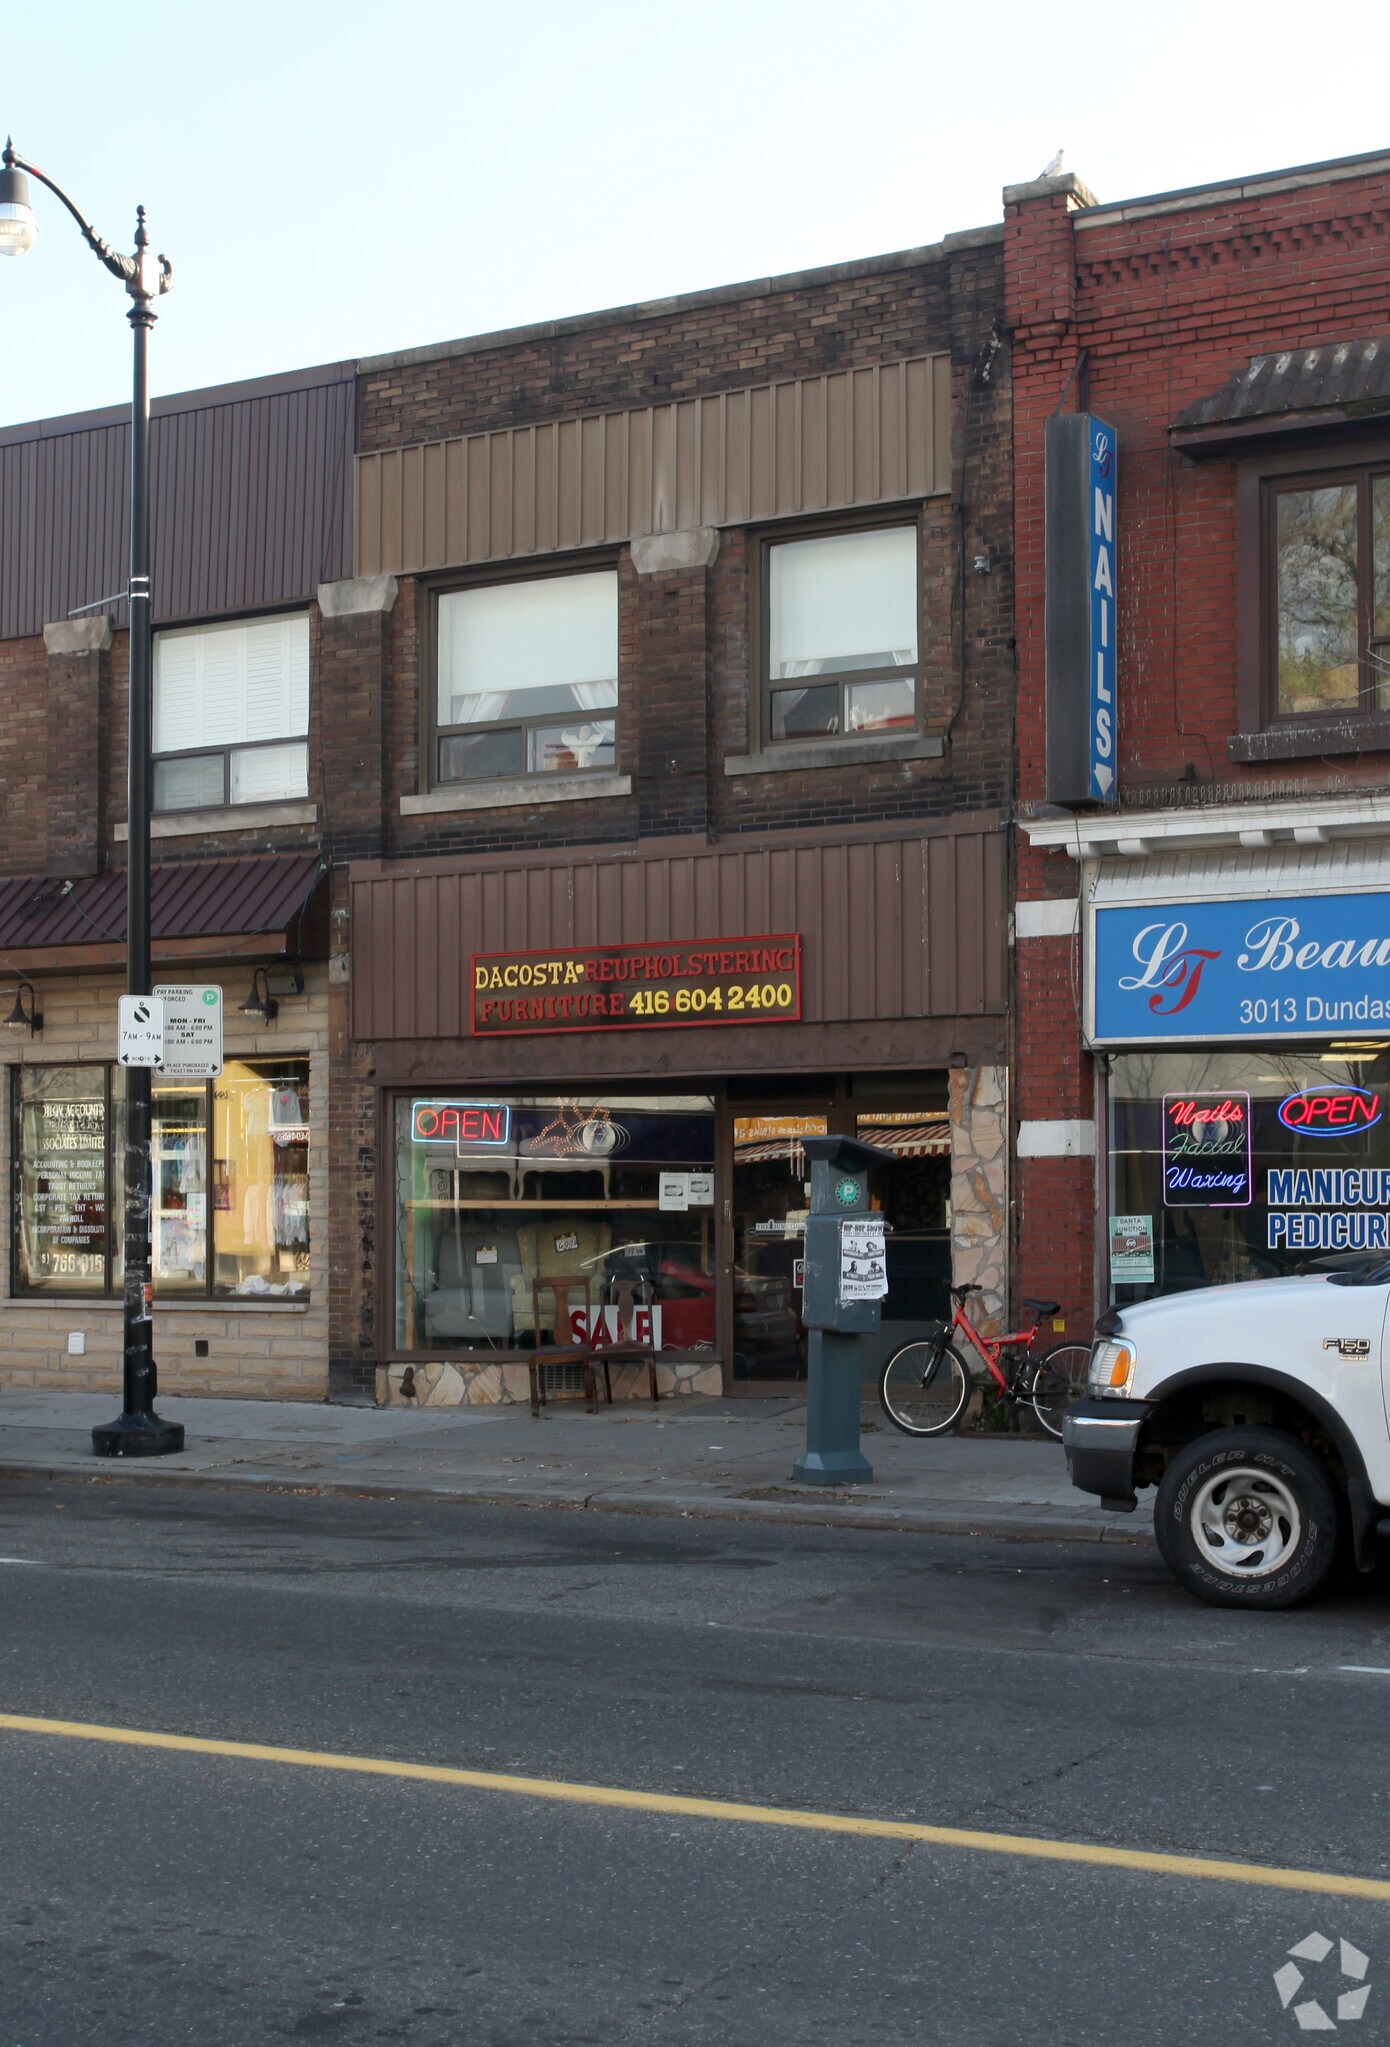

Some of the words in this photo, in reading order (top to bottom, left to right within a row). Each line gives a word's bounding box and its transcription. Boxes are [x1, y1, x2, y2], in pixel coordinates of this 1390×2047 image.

[1094, 486, 1114, 759] NAILS
[475, 961, 579, 989] DACOSTA
[584, 948, 795, 982] REUPHOLSTERING
[480, 992, 626, 1023] FURNITURE
[628, 991, 670, 1015] 416
[675, 987, 723, 1012] 604
[727, 983, 792, 1010] 2400
[1240, 997, 1297, 1024] 3013
[122, 1031, 138, 1041] 7AM
[146, 1031, 162, 1041] 9AM
[1168, 1100, 1245, 1125] Nails
[1283, 1095, 1380, 1125] OPEN
[416, 1109, 501, 1139] OPEN
[1168, 1132, 1246, 1162] Facial
[33, 1160, 68, 1168] ACCOUNTING
[37, 1170, 68, 1179] PERSONAL
[69, 1170, 93, 1179] INCOME
[48, 1182, 66, 1190] TRUST
[68, 1181, 97, 1190] RETURNS
[1166, 1167, 1247, 1194] Waxing
[33, 1192, 67, 1201] CORPORATE
[69, 1192, 81, 1201] TAX
[34, 1203, 46, 1212] GST
[74, 1203, 87, 1212] EHT
[59, 1214, 84, 1223] PAYROLL
[1268, 1212, 1390, 1249] PEDICUR
[60, 1235, 91, 1244] COMPANIES
[1174, 1450, 1246, 1522] DUELER
[1189, 1519, 1318, 1594] BRIDGESTONE
